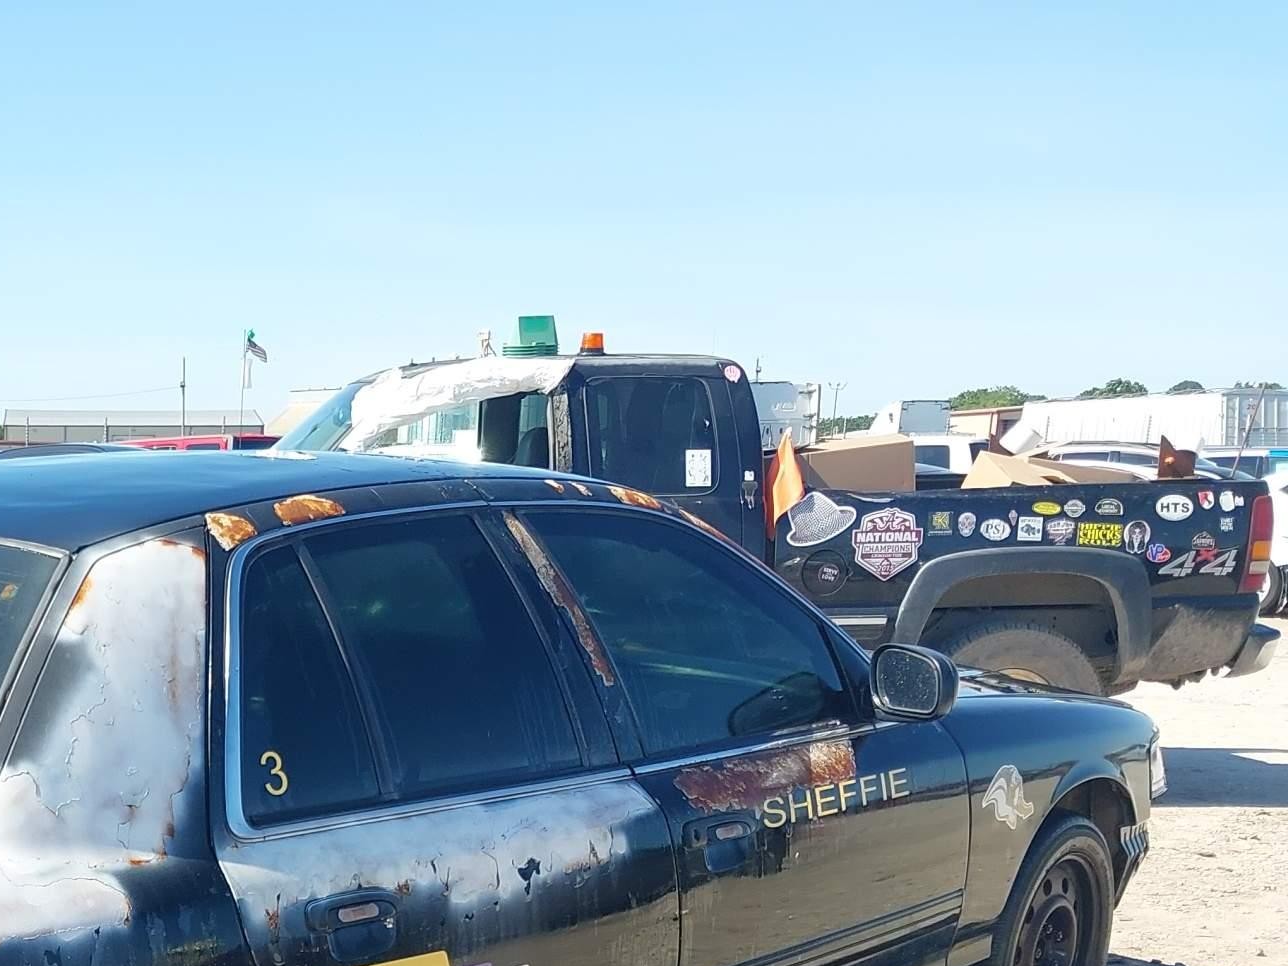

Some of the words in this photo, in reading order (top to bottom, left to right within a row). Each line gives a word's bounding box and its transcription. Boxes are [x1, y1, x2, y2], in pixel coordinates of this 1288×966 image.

[1160, 502, 1190, 513] HTS
[856, 532, 918, 543] NATIONAL
[1079, 529, 1121, 540] CHICKS
[863, 544, 910, 553] CHAMPIONS
[260, 751, 288, 796] 3
[762, 767, 911, 829] SHEFFIE
